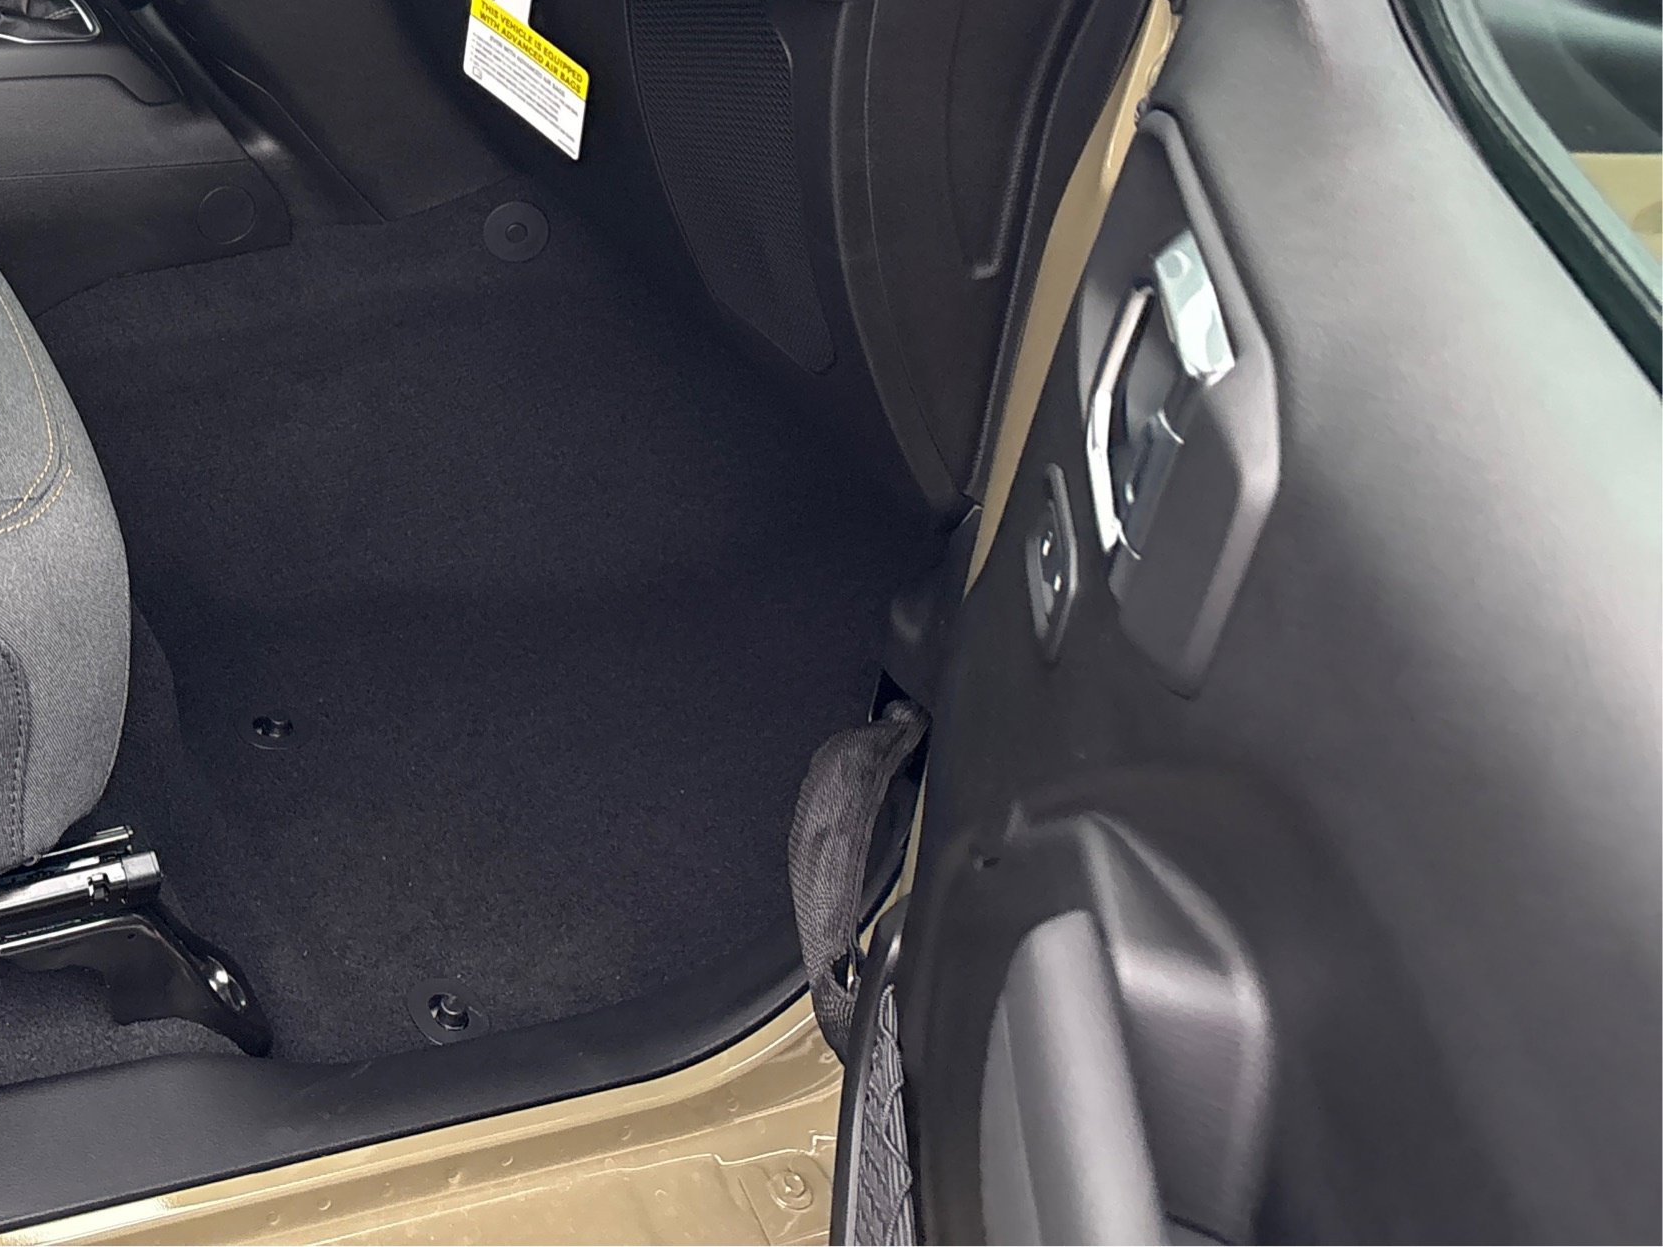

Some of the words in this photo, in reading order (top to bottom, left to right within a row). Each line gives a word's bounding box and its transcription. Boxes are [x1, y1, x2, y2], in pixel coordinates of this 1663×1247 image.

[478, 9, 500, 32] WITH
[500, 25, 544, 65] ADVANCED
[544, 58, 558, 76] AIR
[559, 70, 582, 95] BAGS
[480, 0, 499, 20] THIS
[499, 13, 533, 45] VEHICLE
[533, 39, 542, 52] IS
[542, 46, 583, 84] EQUIPPED
